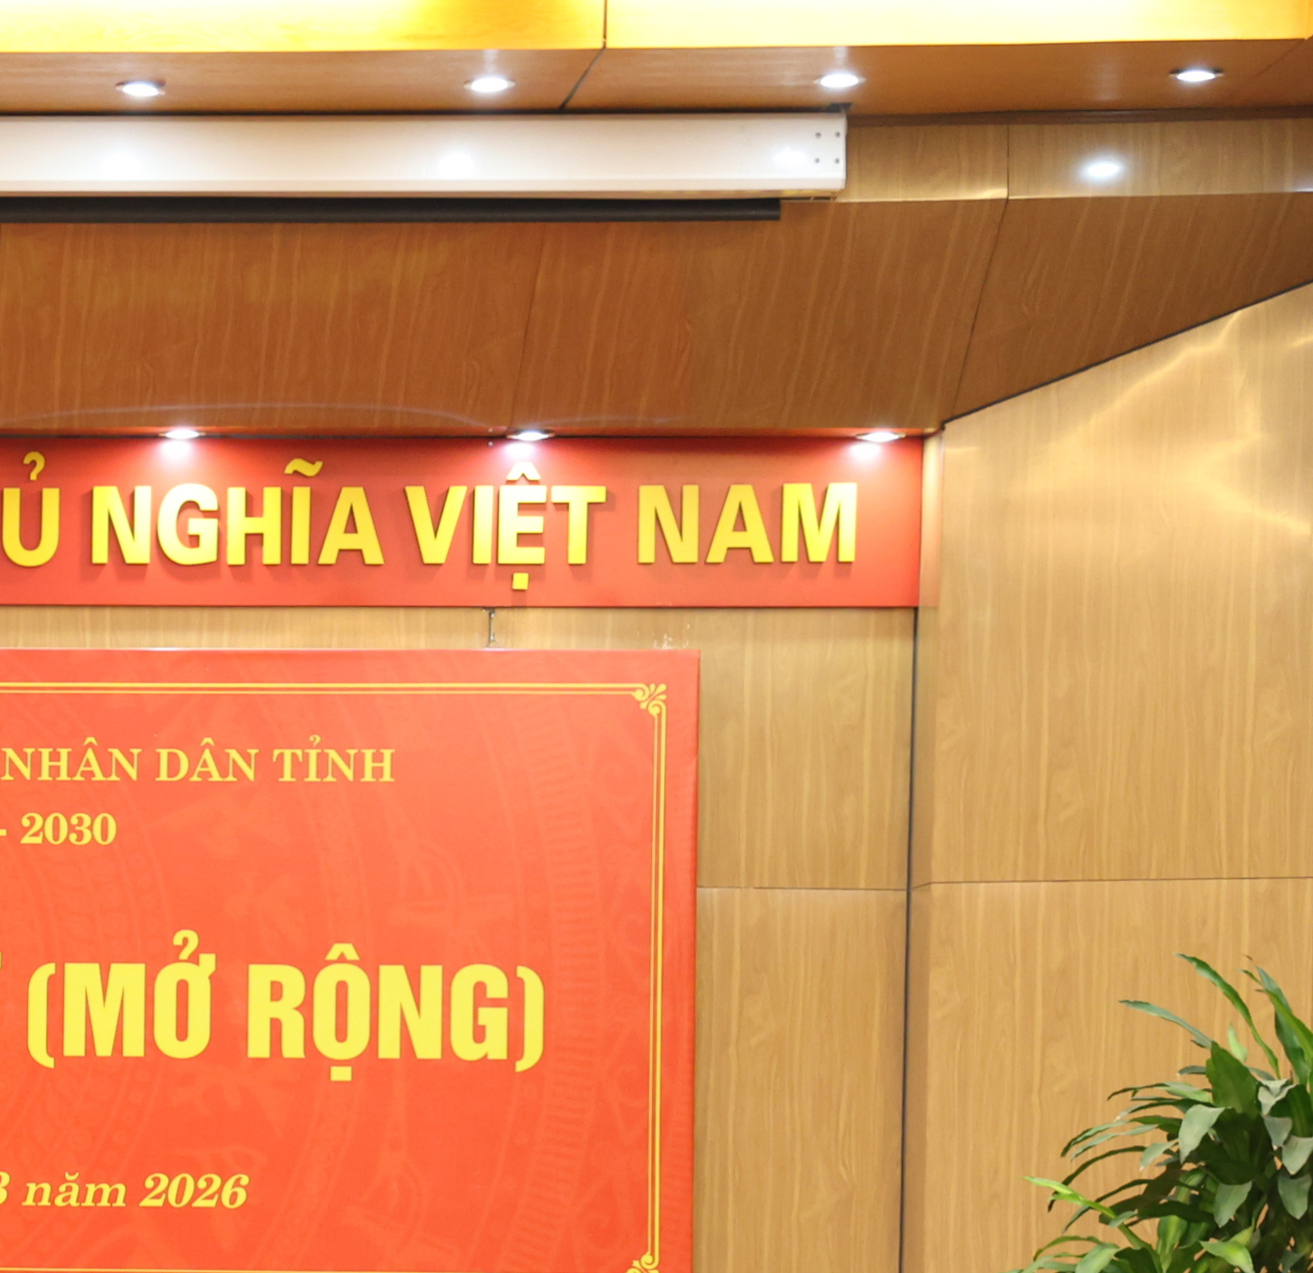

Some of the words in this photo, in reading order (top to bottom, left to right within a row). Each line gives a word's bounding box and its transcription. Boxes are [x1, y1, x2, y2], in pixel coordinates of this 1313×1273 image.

[91, 459, 385, 565] NGHĨA
[405, 461, 607, 590] VIỆT
[637, 482, 858, 564] NAM
[0, 736, 142, 781] NHÂN
[155, 737, 260, 782] DÂN
[272, 734, 396, 782] TỈNH
[20, 812, 117, 846] 2030
[27, 929, 217, 1069] (MỞ
[247, 942, 545, 1082] RỘNG)
[21, 1172, 126, 1207] năm
[139, 1173, 250, 1209] 2026
